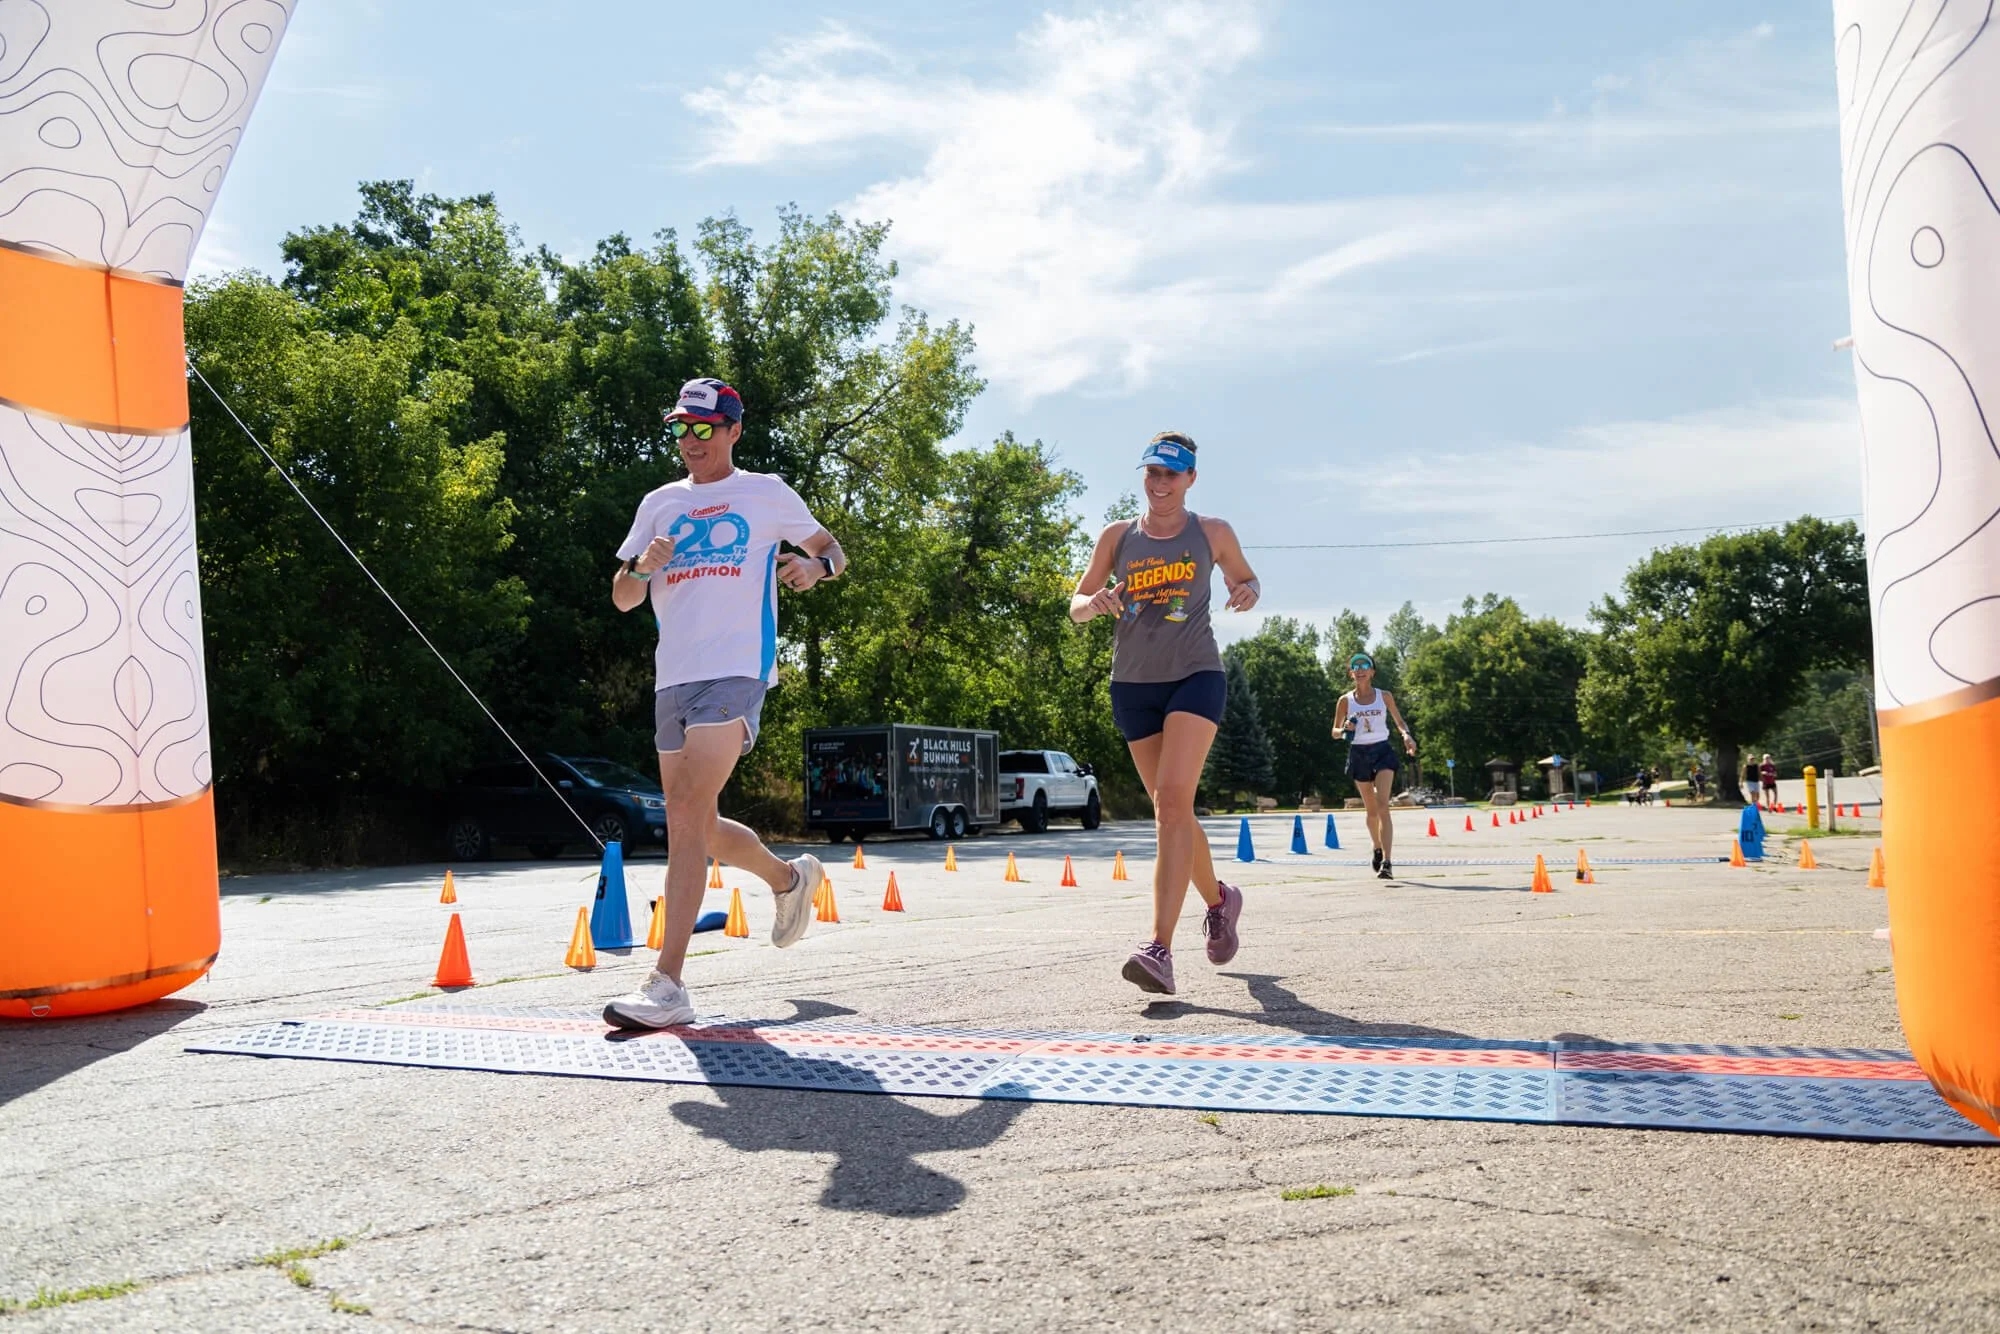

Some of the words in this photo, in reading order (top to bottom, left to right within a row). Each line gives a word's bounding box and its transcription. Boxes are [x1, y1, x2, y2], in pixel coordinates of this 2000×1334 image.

[666, 565, 742, 586] MARATHON
[1127, 561, 1197, 594] LEGENDS
[923, 738, 949, 751] BLACK
[950, 740, 971, 752] HILLS
[923, 751, 960, 764] RUNNING
